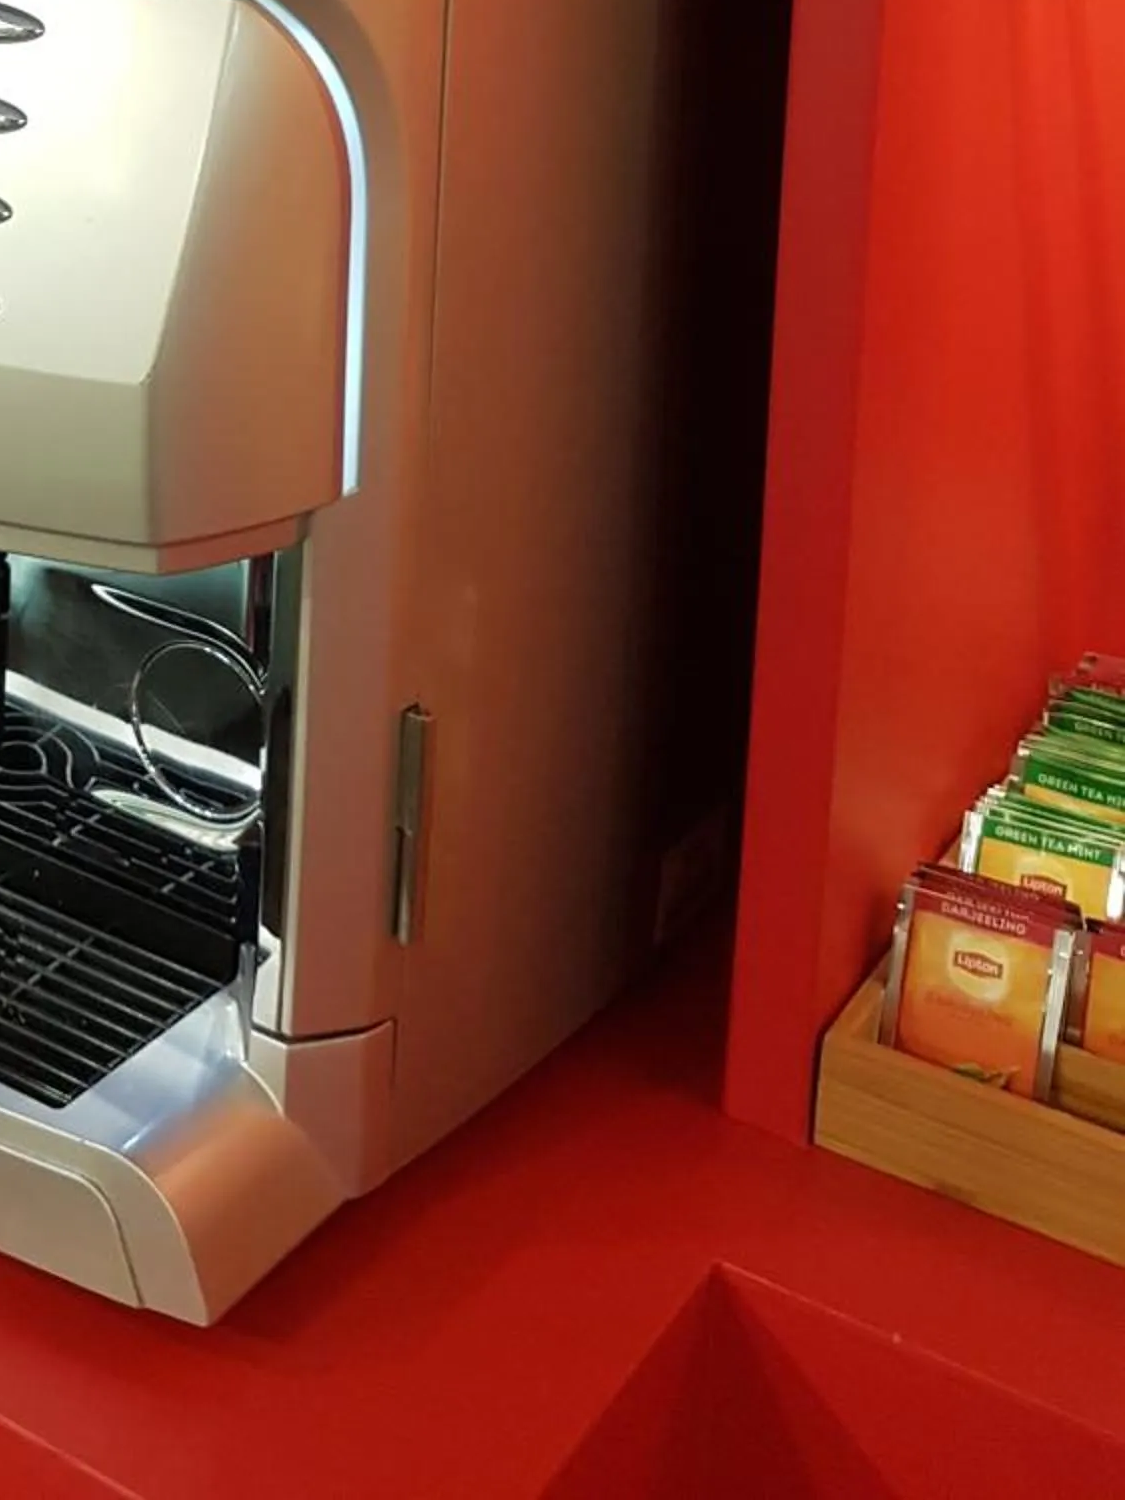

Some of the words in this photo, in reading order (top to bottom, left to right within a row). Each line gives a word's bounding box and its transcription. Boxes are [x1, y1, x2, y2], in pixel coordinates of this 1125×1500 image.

[1038, 772, 1078, 795] GREEN
[1080, 785, 1104, 803] TEA
[995, 825, 1037, 846] GREEN
[1040, 835, 1064, 852] TEA
[1066, 843, 1100, 861] MINT
[1022, 874, 1063, 897] Lipton
[941, 901, 1026, 936] DARJEELING
[957, 954, 1000, 977] Lipton
